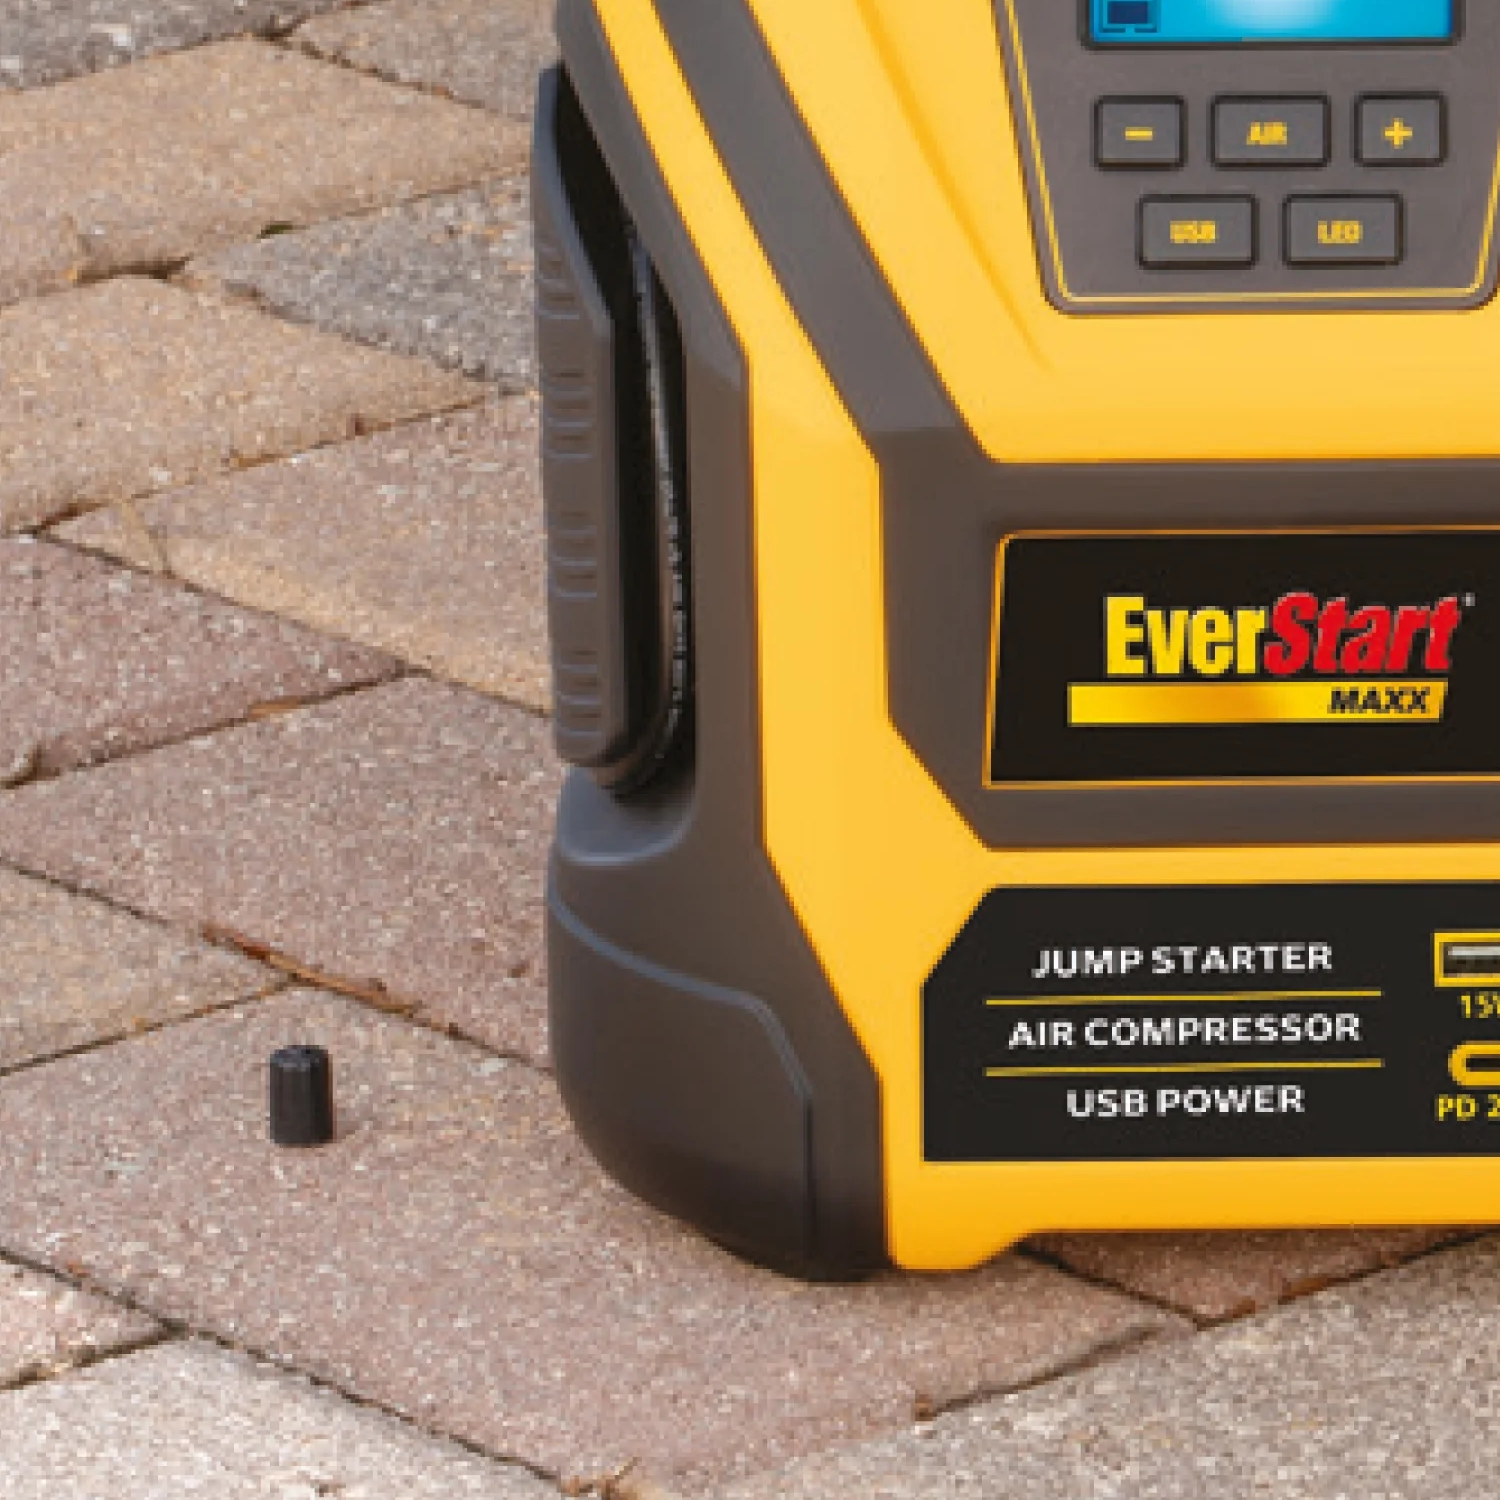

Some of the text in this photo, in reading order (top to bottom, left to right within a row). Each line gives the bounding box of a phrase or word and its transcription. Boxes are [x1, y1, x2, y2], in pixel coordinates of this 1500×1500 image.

[1245, 120, 1289, 147] AIR
[1168, 219, 1218, 244] USB
[1316, 219, 1364, 245] LED
[1104, 592, 1461, 677] EverStart
[1326, 685, 1432, 715] MAXX
[1031, 942, 1334, 979] JUMP STARTER
[1007, 1012, 1362, 1050] AIR COMPRESSOR
[1066, 1083, 1306, 1119] USB POWER
[1435, 1094, 1478, 1122] PD
